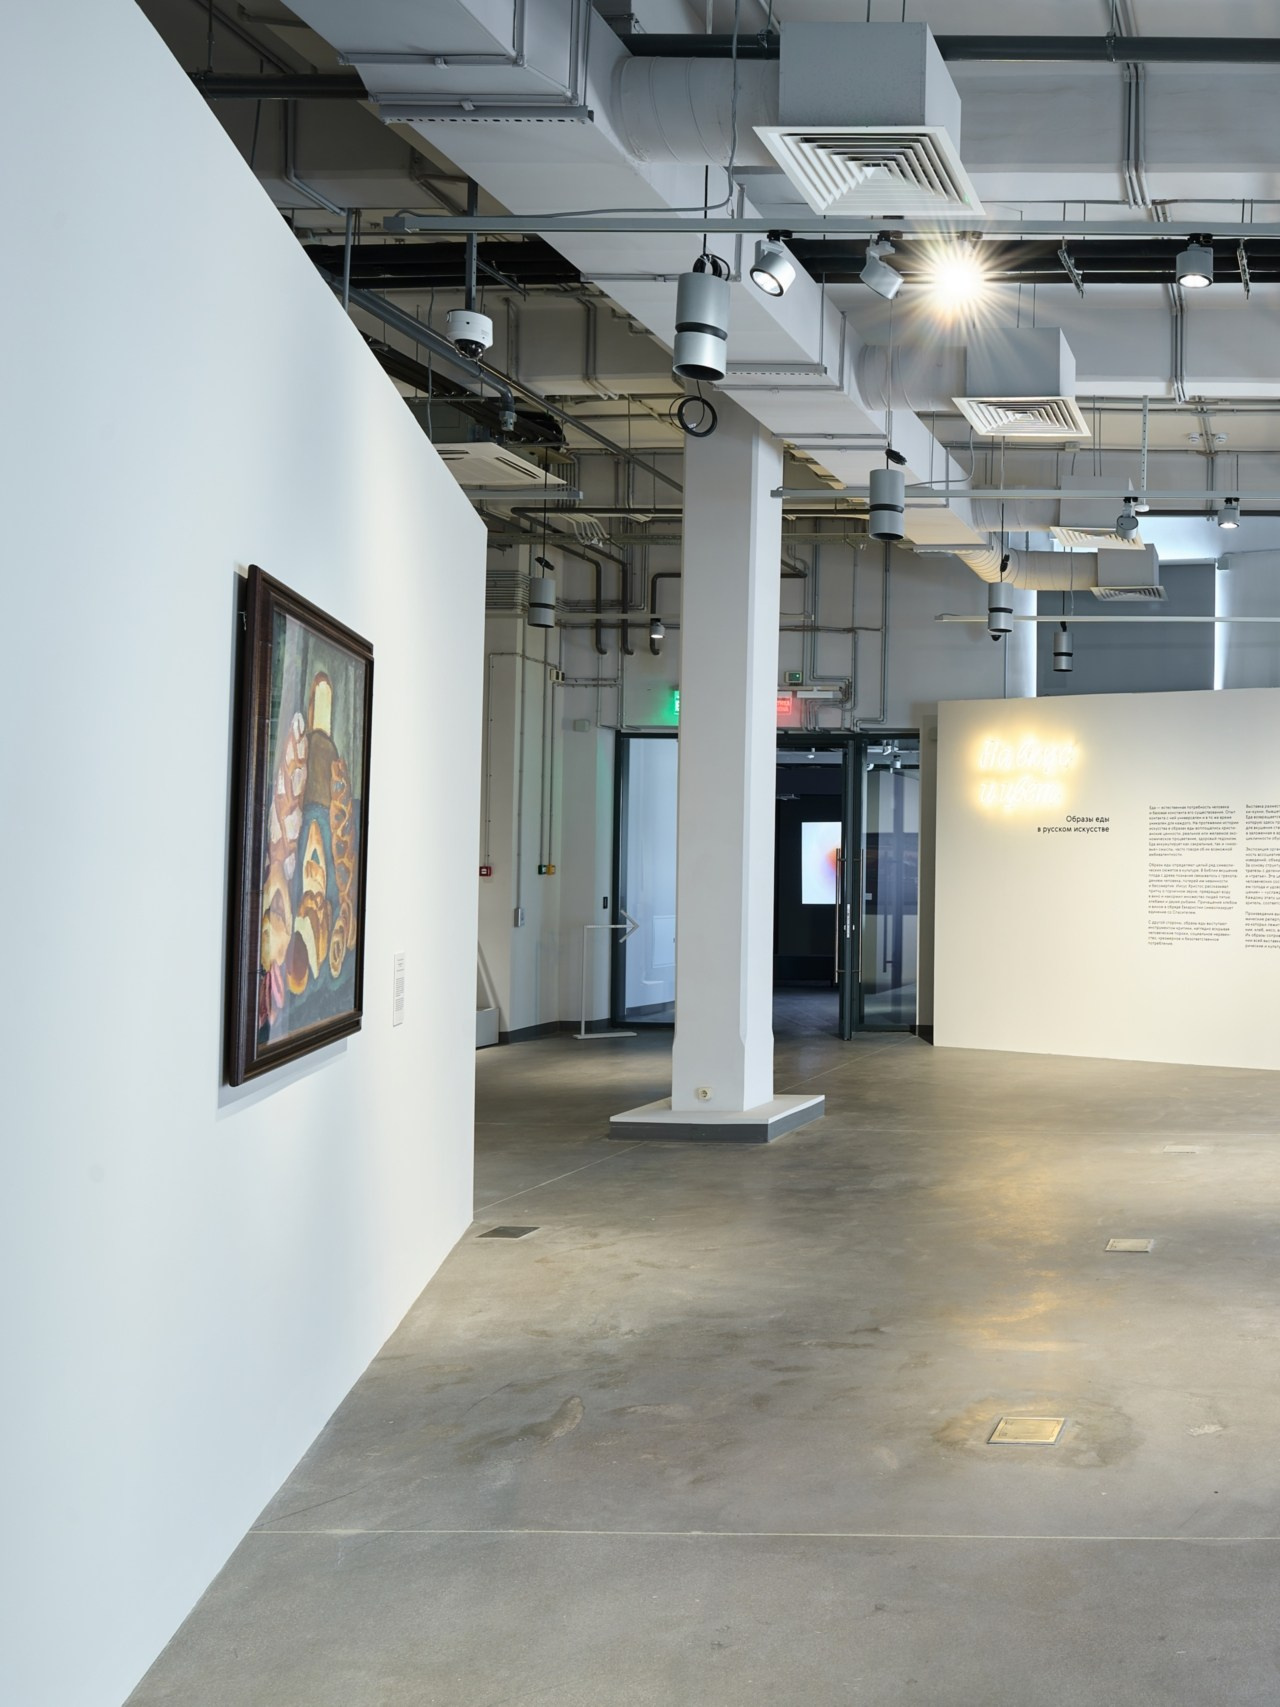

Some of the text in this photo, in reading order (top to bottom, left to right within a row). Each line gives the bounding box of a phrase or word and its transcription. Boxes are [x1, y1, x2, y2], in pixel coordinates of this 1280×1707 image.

[1066, 815, 1093, 824] Образы
[1042, 826, 1072, 834] русском
[1073, 826, 1109, 834] искусстве
